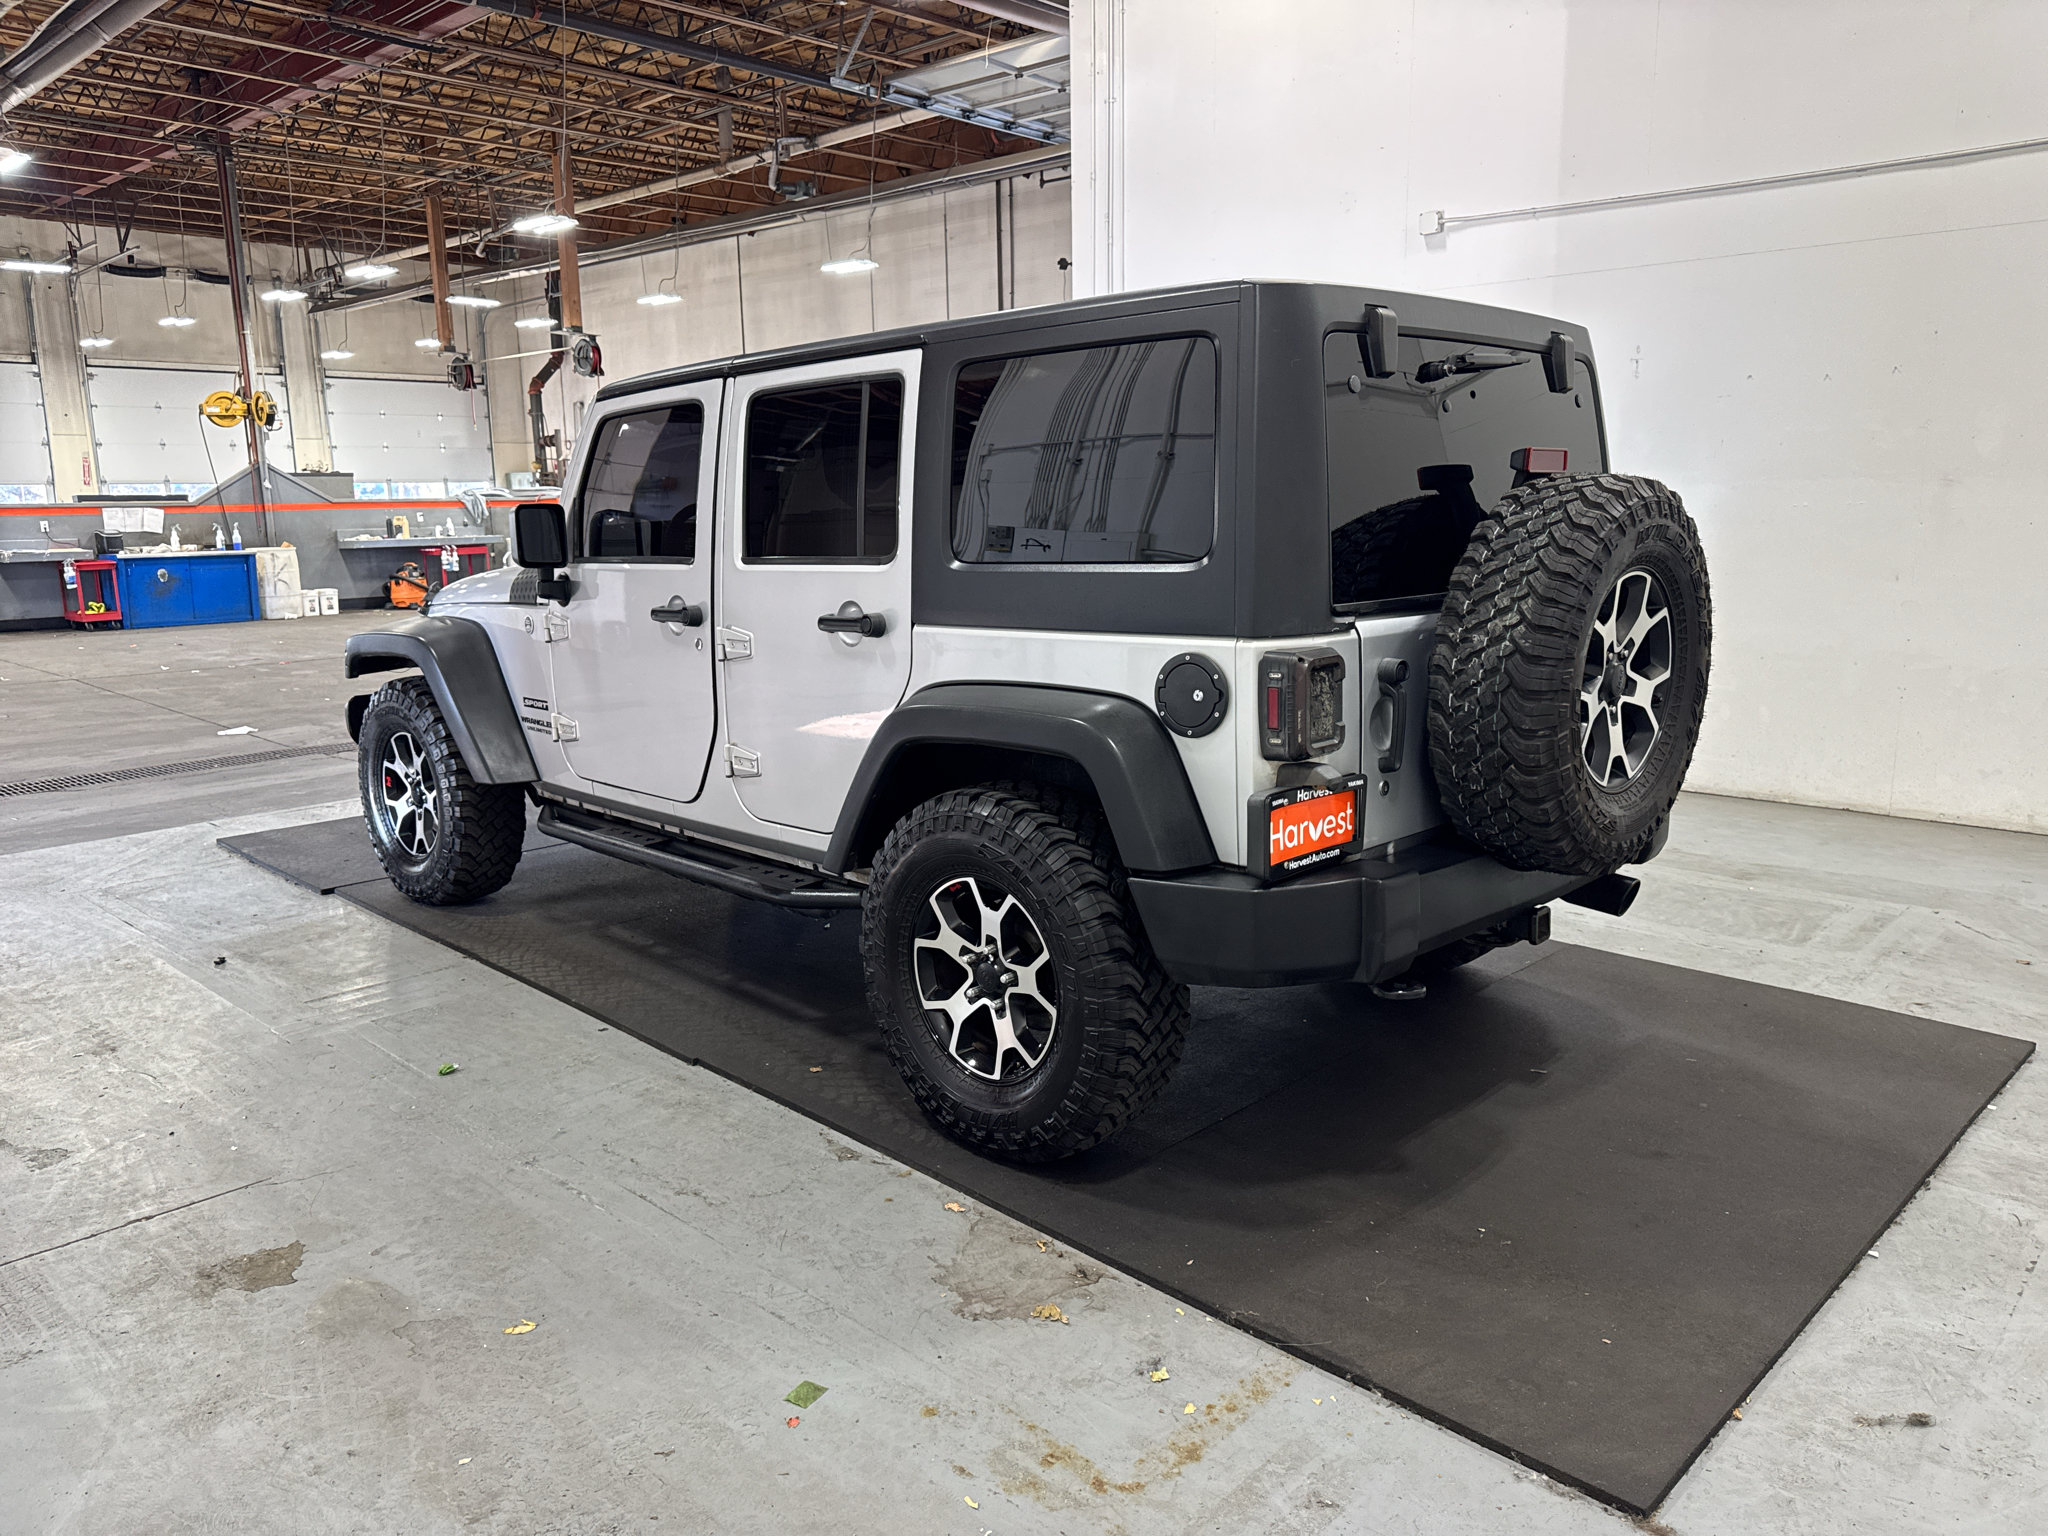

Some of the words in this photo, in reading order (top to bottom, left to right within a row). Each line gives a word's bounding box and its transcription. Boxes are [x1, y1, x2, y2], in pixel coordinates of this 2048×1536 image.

[524, 698, 548, 710] SPORT
[1270, 801, 1353, 854] Harvest
[1289, 848, 1340, 870] HarvestAuto.com
